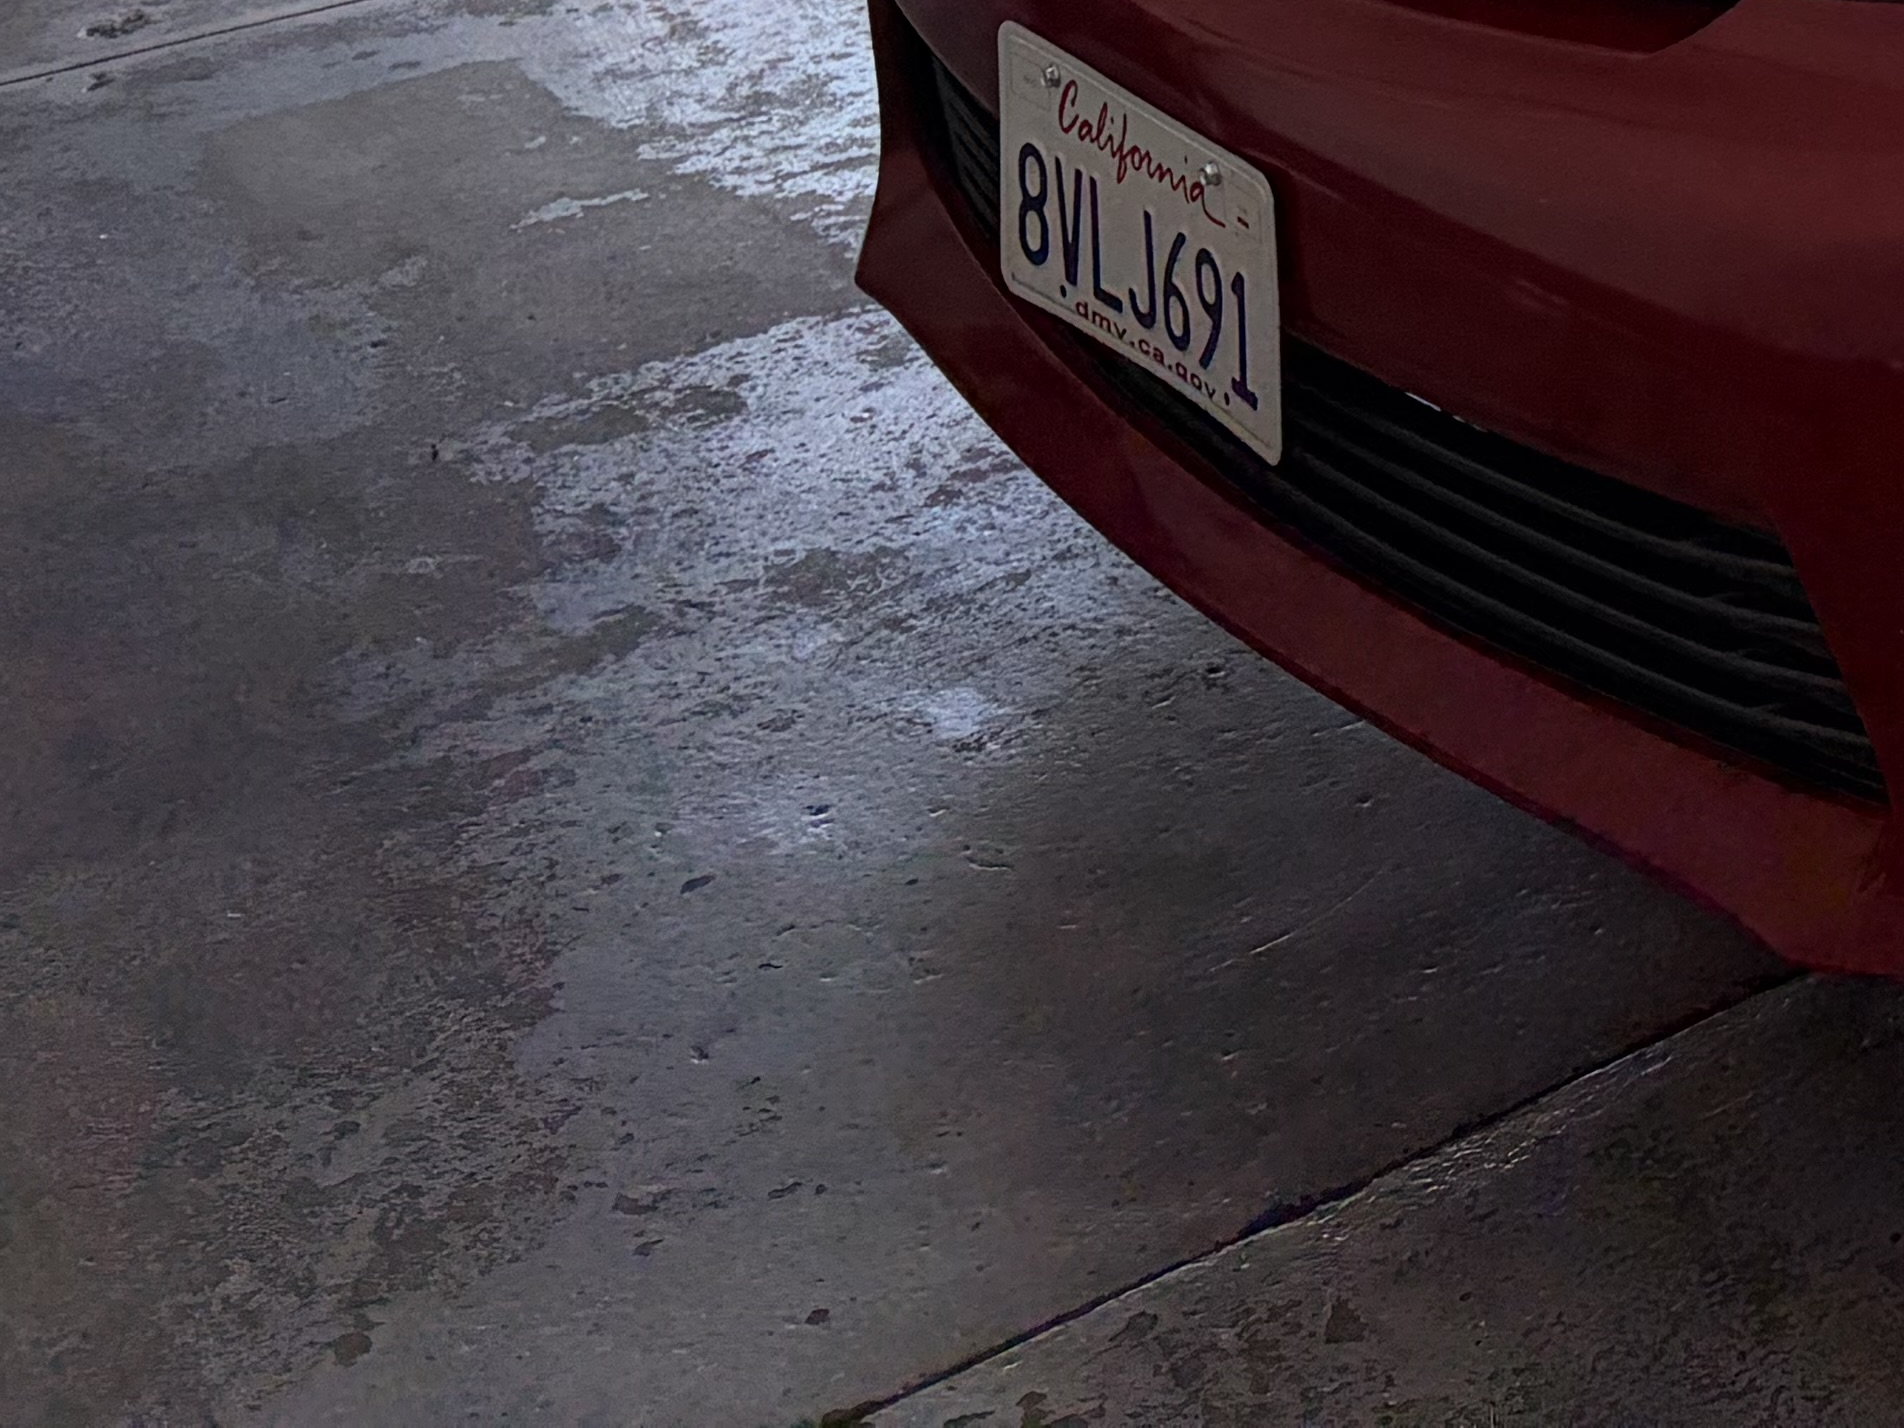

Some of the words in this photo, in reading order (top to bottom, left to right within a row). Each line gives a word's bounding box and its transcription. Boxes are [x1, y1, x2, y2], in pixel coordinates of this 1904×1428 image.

[1058, 79, 1227, 228] California
[1018, 142, 1258, 412] 8VLJ691
[1075, 301, 1217, 401] dmv.ca.gov
